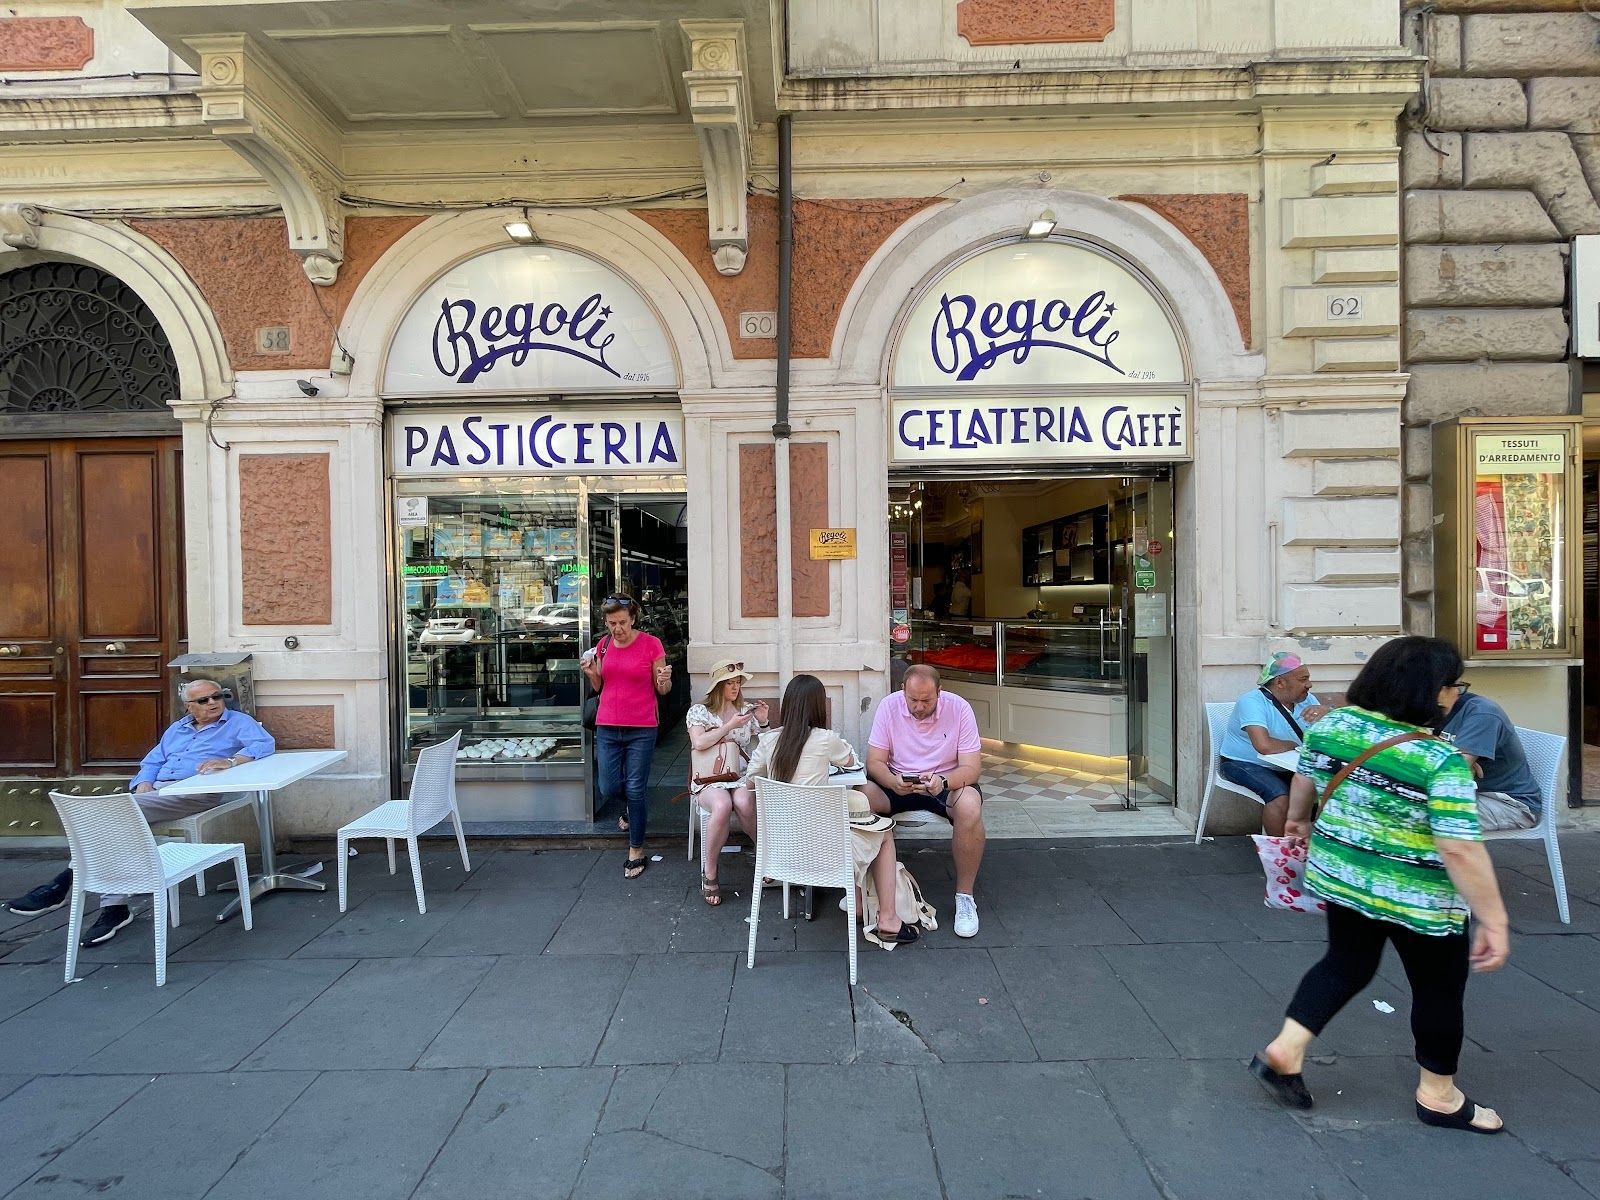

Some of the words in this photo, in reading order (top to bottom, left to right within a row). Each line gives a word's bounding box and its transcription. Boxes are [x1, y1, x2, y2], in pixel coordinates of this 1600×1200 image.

[1330, 297, 1360, 316] 62
[745, 316, 772, 334] 60
[262, 331, 288, 349] 58
[432, 293, 621, 383] Regoli
[930, 290, 1126, 381] Regoli
[622, 372, 636, 381] dal
[1128, 370, 1141, 379] dal
[1142, 370, 1156, 380] 1916
[898, 406, 1094, 450] GELATERIA
[1101, 405, 1182, 451] CAFFÈ
[404, 414, 678, 468] PASTICCERIA
[1501, 440, 1539, 448] TESSUTI
[1479, 453, 1561, 462] D'ARREDAMENTO
